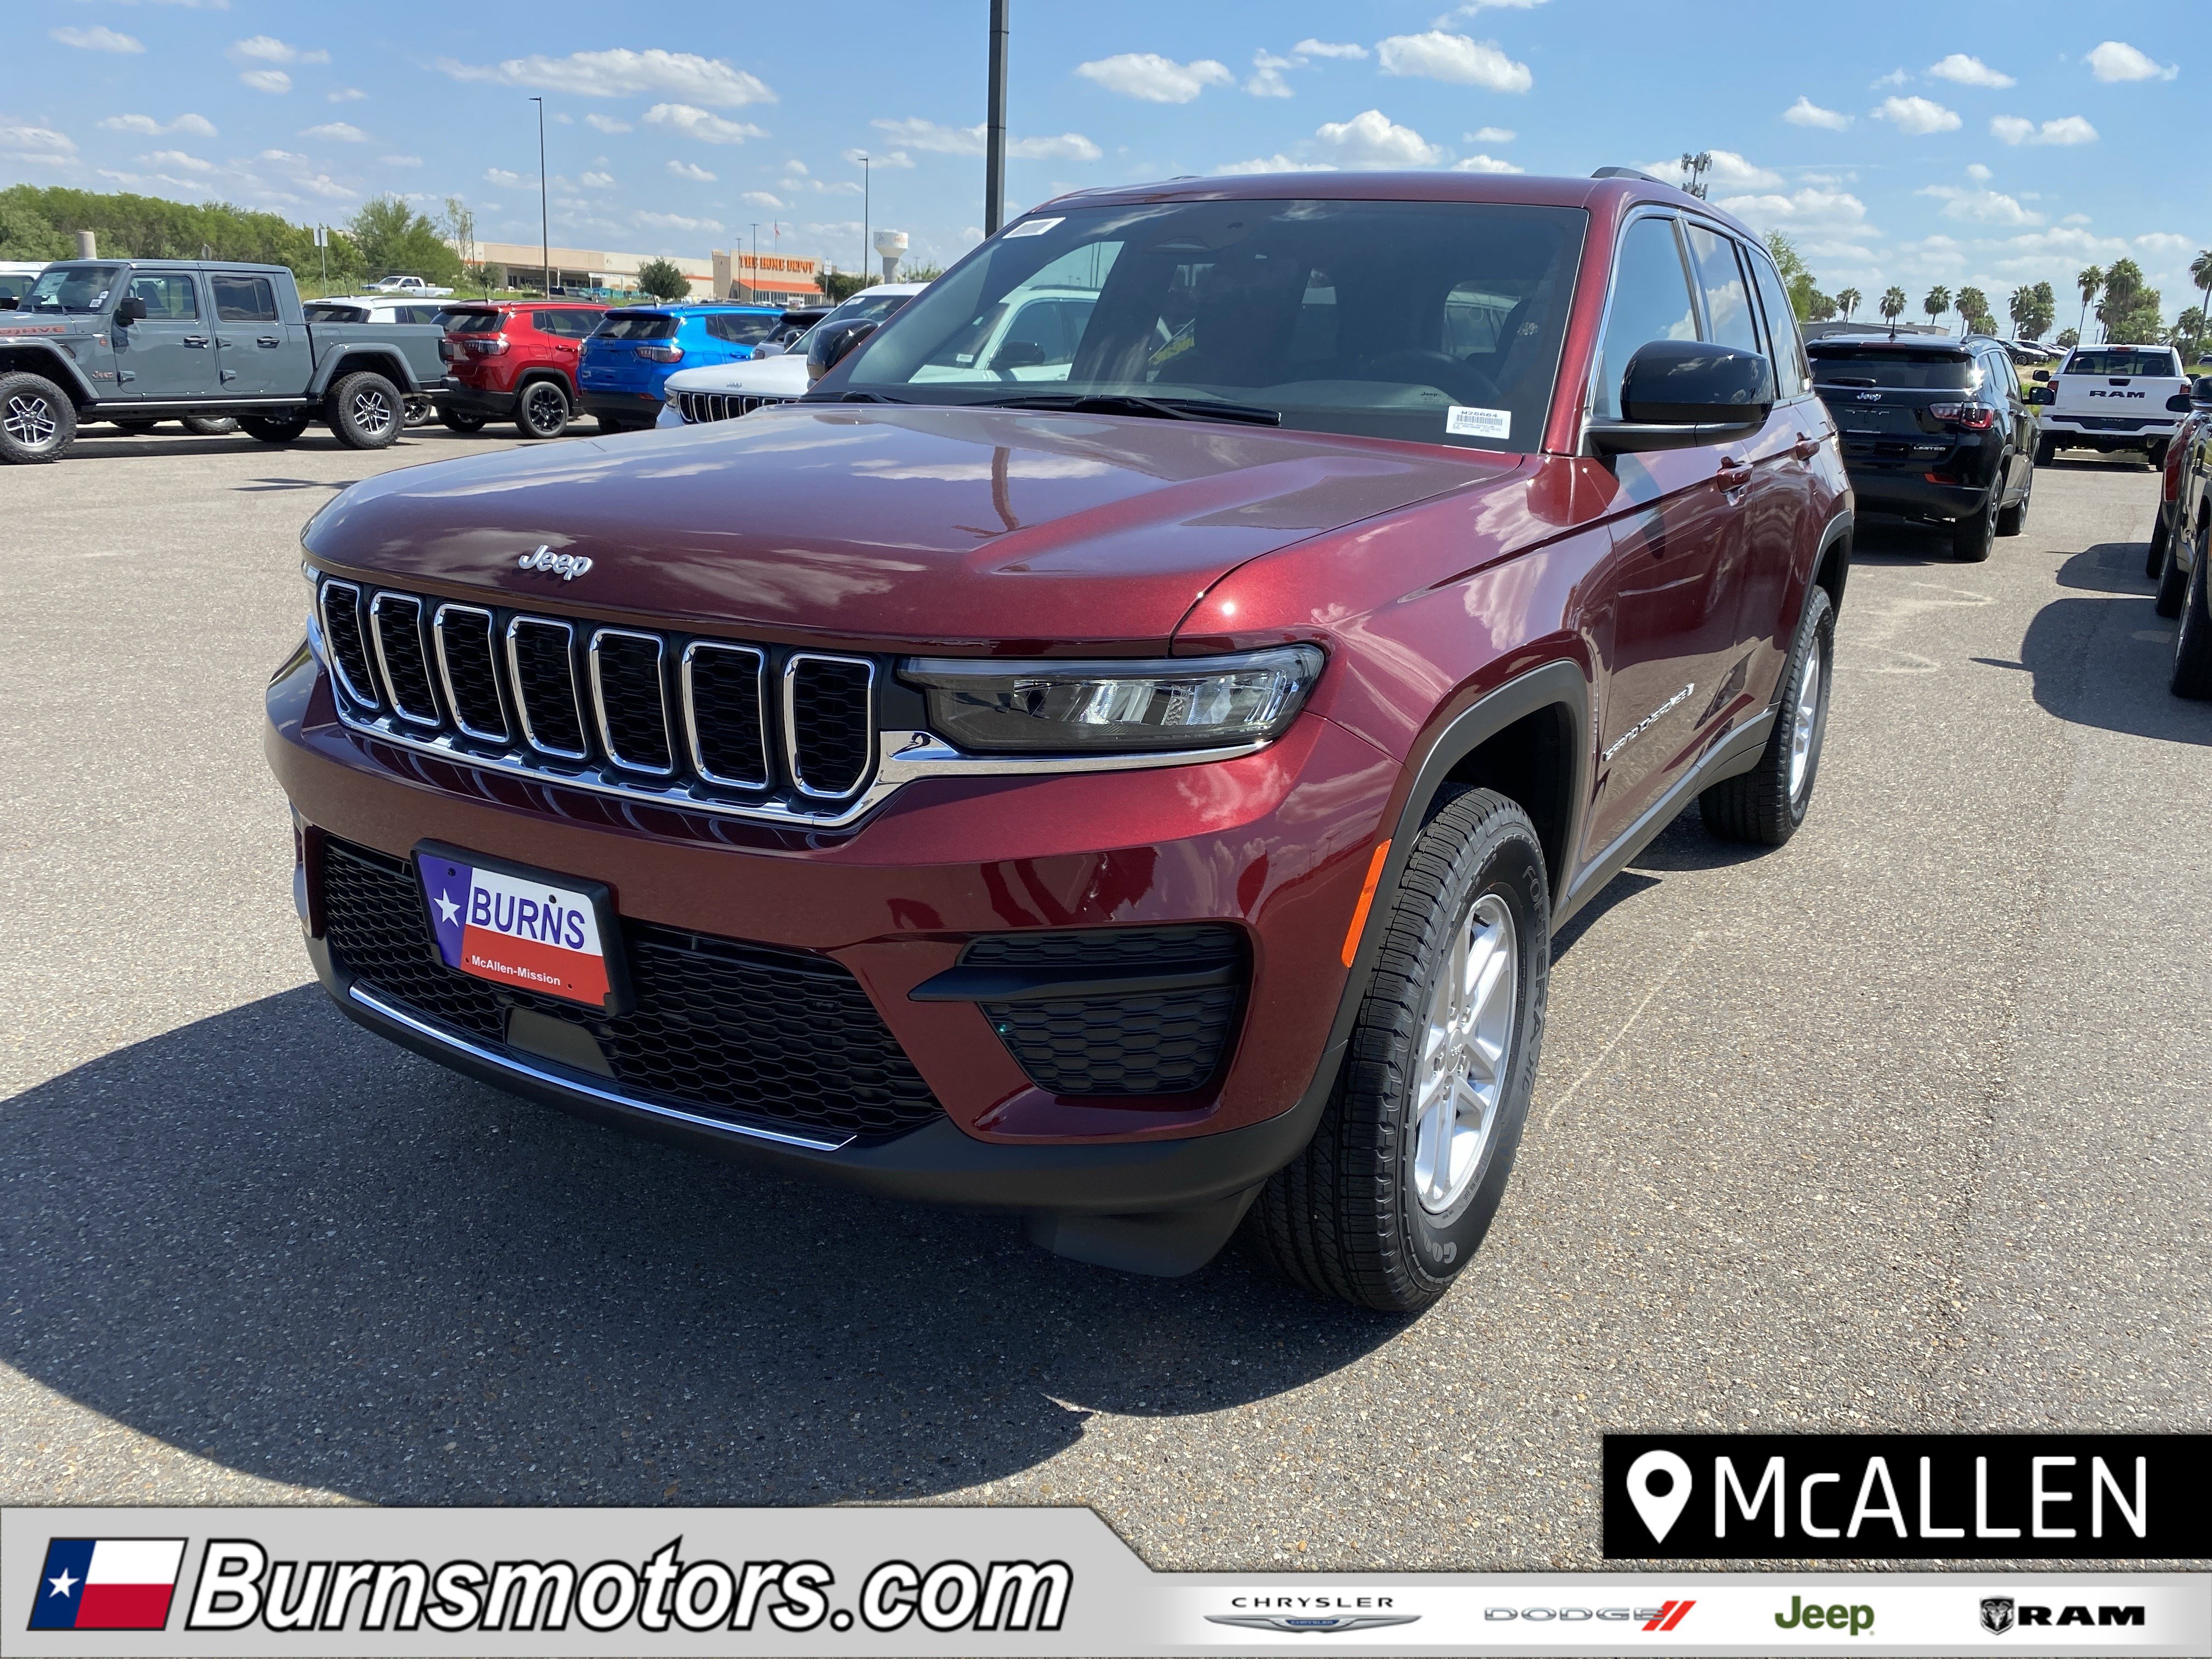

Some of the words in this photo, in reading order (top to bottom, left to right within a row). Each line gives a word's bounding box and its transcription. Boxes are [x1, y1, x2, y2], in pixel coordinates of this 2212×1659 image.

[740, 256, 757, 268] THE
[760, 257, 785, 271] HOME
[787, 259, 815, 274] DEPOT
[0, 326, 65, 335] OJAVE
[1857, 392, 1882, 402] Jeep
[518, 545, 592, 581] Jeep
[472, 887, 585, 949] BURNS
[471, 955, 561, 986] McAllen-Mission
